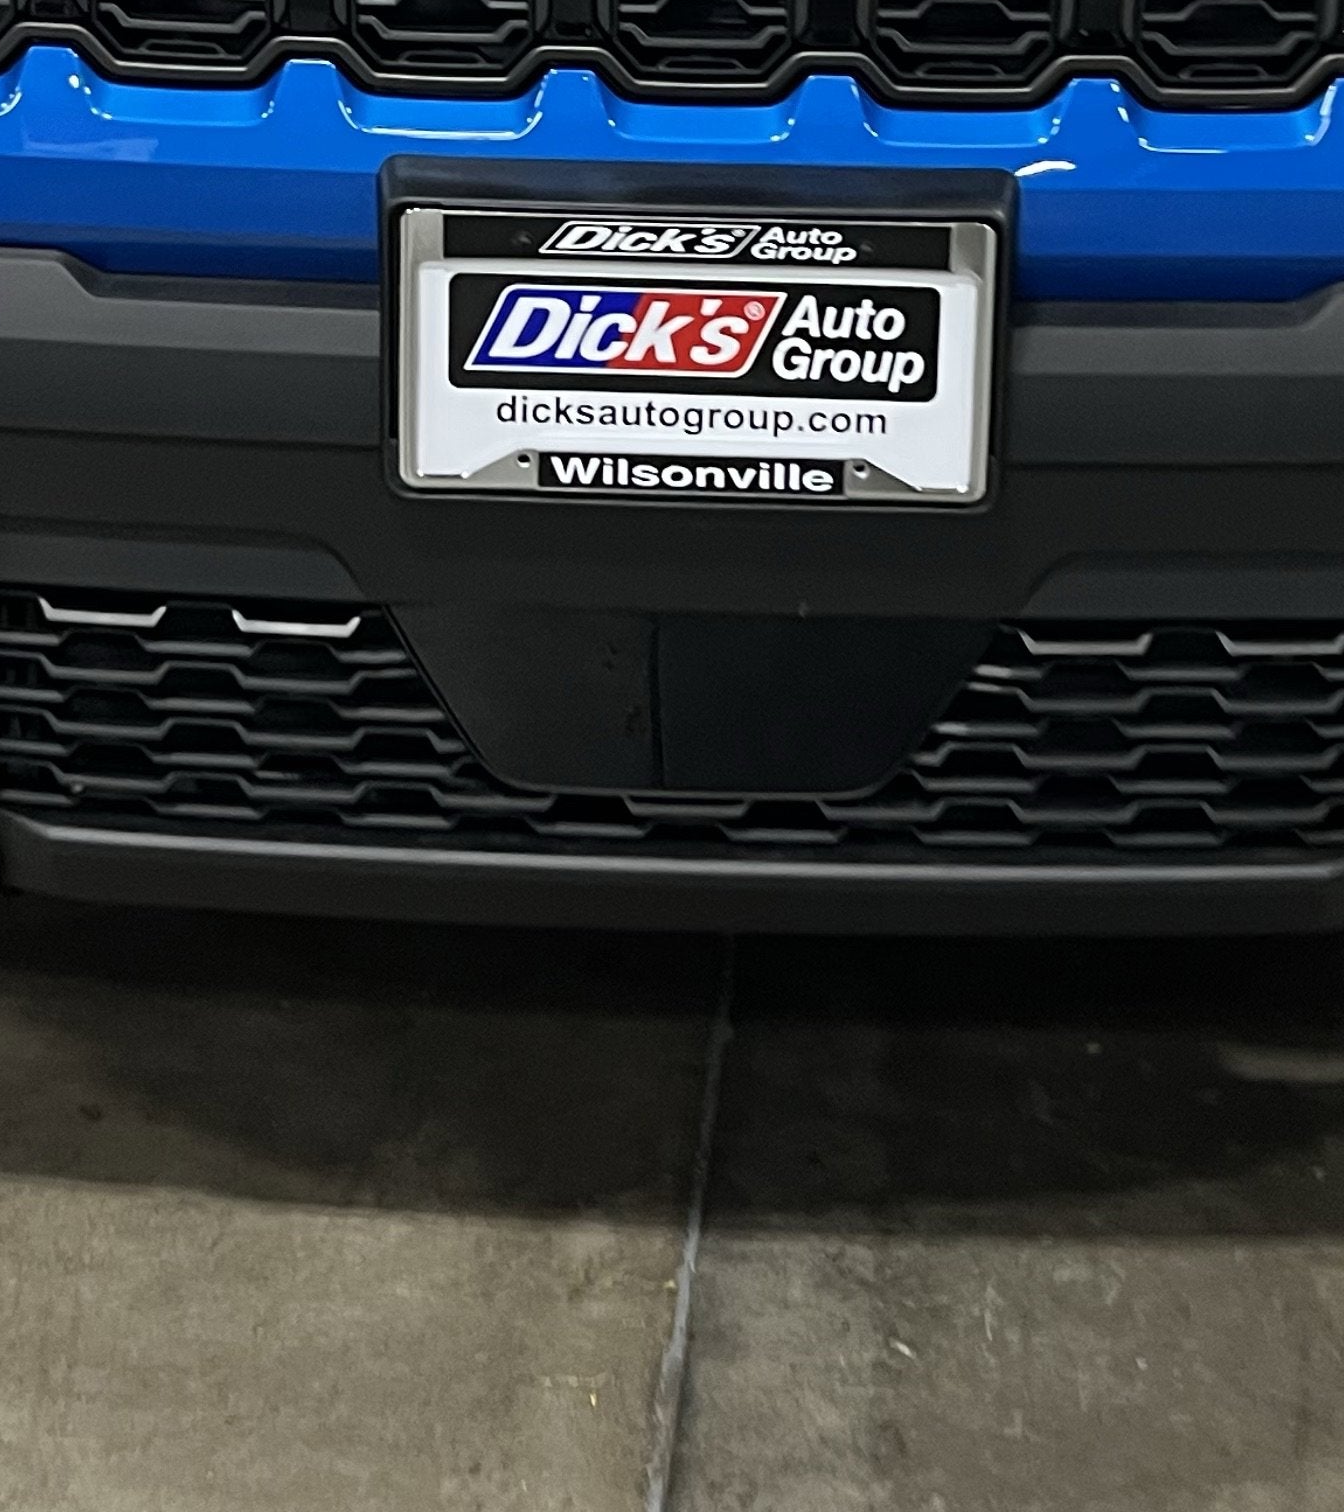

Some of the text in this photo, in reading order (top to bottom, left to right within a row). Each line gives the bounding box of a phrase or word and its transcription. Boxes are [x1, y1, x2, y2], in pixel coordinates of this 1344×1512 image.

[556, 226, 843, 254] Dick's Auto
[750, 242, 857, 264] Group
[488, 294, 906, 366] Dick's Auto
[771, 338, 926, 393] Group
[496, 395, 887, 437] dicksautogroup.com
[550, 455, 835, 492] Wilsonville
